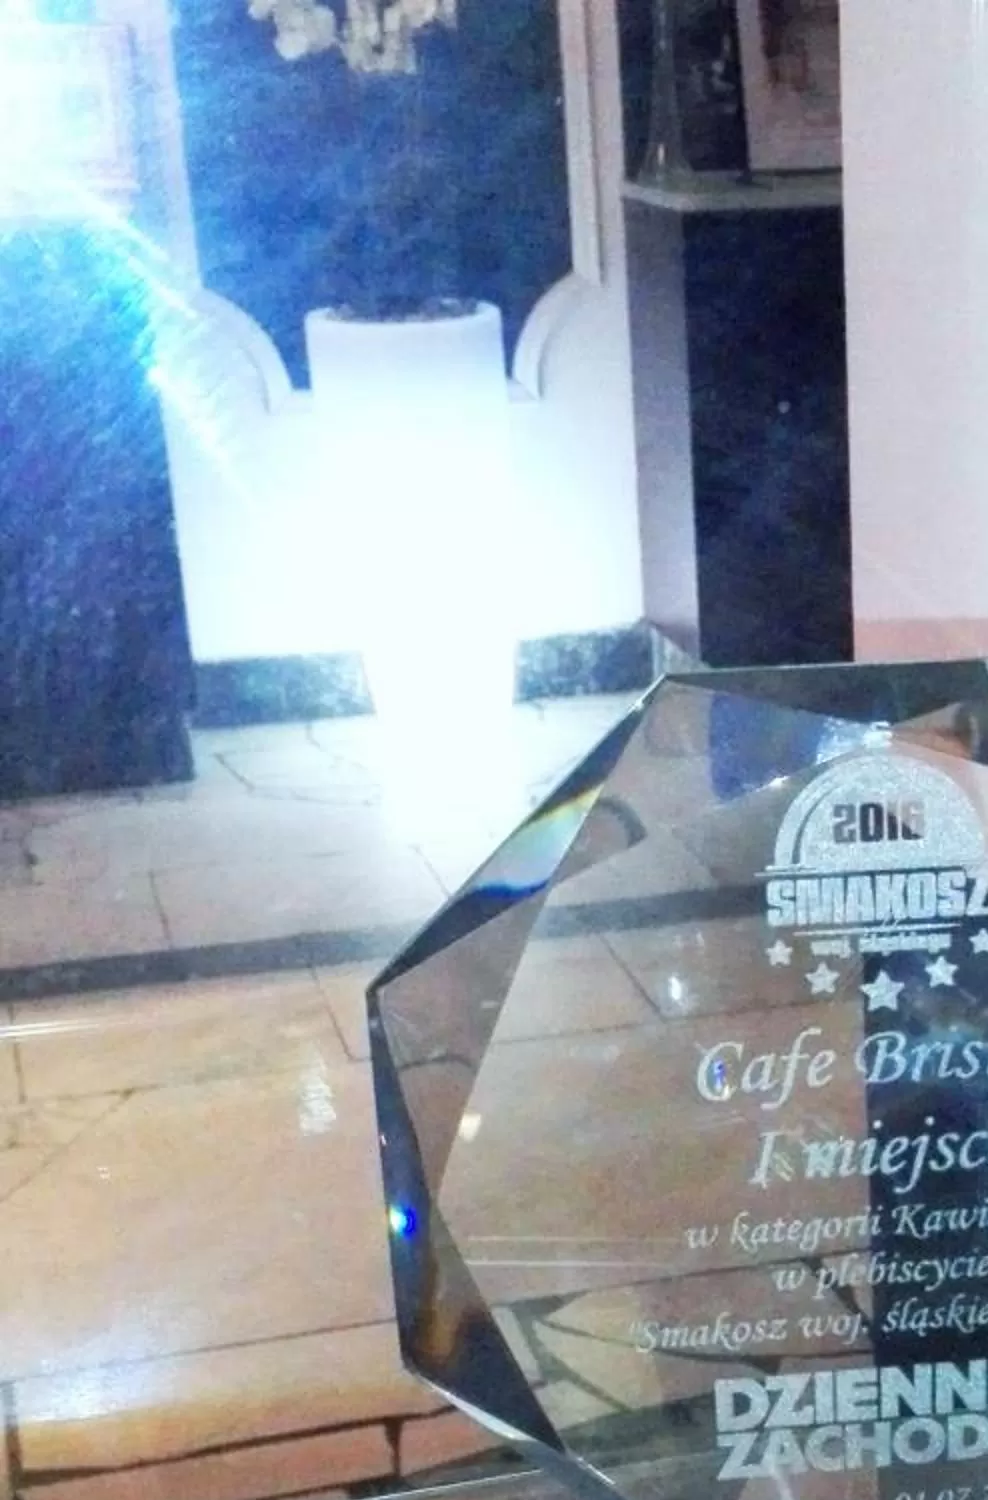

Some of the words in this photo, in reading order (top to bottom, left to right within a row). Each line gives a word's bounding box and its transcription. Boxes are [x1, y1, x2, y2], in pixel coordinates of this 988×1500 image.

[832, 801, 926, 844] 2016
[697, 1027, 837, 1111] Cafe
[684, 1225, 719, 1250] w
[729, 1205, 882, 1252] kategorii
[769, 1266, 806, 1292] w
